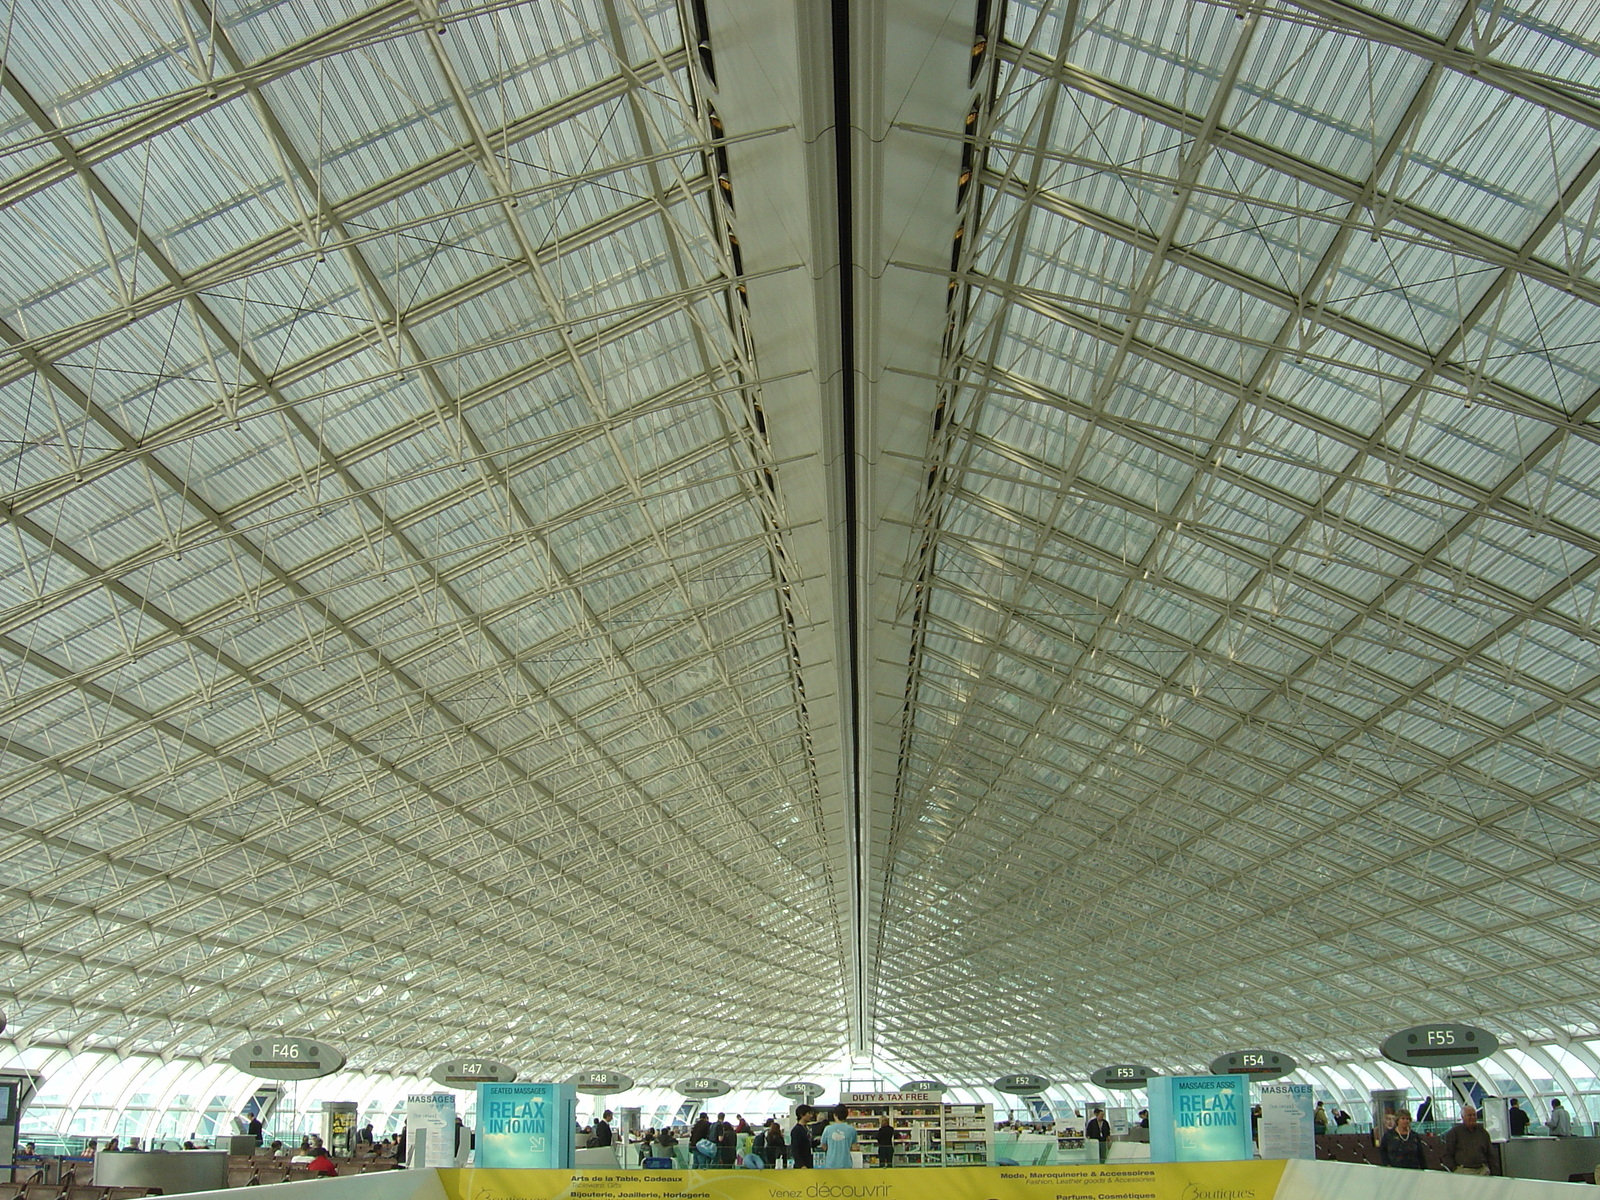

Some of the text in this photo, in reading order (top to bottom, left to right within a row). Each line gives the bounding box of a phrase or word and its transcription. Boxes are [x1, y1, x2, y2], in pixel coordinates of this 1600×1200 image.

[1427, 1031, 1455, 1045] F55
[272, 1044, 299, 1058] F46
[1243, 1055, 1264, 1066] F54
[462, 1064, 482, 1074] F47
[1117, 1068, 1134, 1078] F53
[590, 1074, 607, 1083] F48
[1179, 1081, 1236, 1090] MASSAGES ASSIS
[1261, 1086, 1312, 1094] MASSAGES
[491, 1087, 546, 1095] SEATED MASSAGES
[407, 1095, 455, 1103] MASSAGES
[852, 1094, 876, 1102] DUTY
[887, 1093, 904, 1101] TAX
[905, 1093, 929, 1101] FREE
[1180, 1094, 1236, 1112] RELAX
[490, 1102, 545, 1118] RELAX
[1180, 1112, 1237, 1127] IN 10 MN
[490, 1120, 545, 1133] IN 10 MN
[1029, 1171, 1088, 1179] Maroquinerie
[769, 1182, 892, 1198] Venez découvrir
[1182, 1180, 1255, 1200] Boutiques
